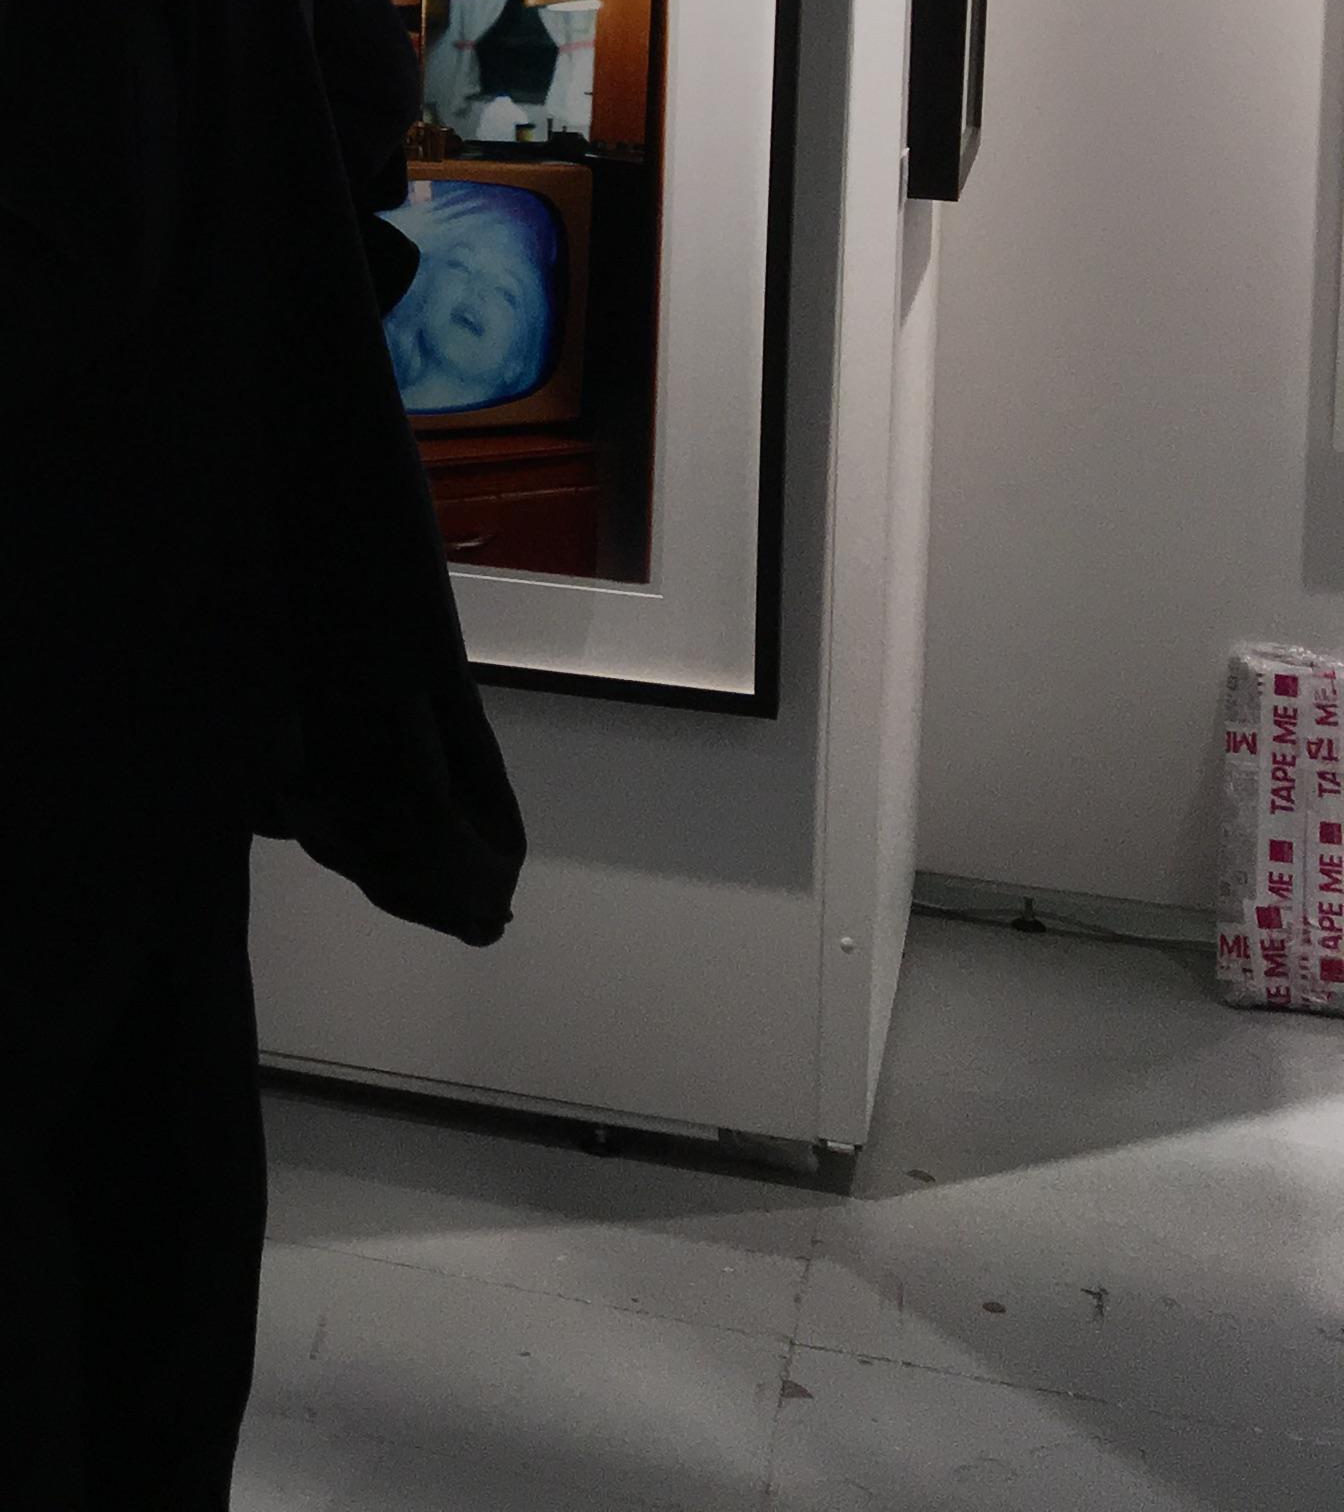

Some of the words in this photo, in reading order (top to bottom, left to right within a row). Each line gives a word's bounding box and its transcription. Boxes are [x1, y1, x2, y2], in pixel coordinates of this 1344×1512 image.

[1272, 704, 1298, 745] ME
[1269, 751, 1297, 815] TAPE
[1318, 853, 1344, 894] ME
[1317, 901, 1344, 952] APE
[1260, 938, 1290, 978] ME
